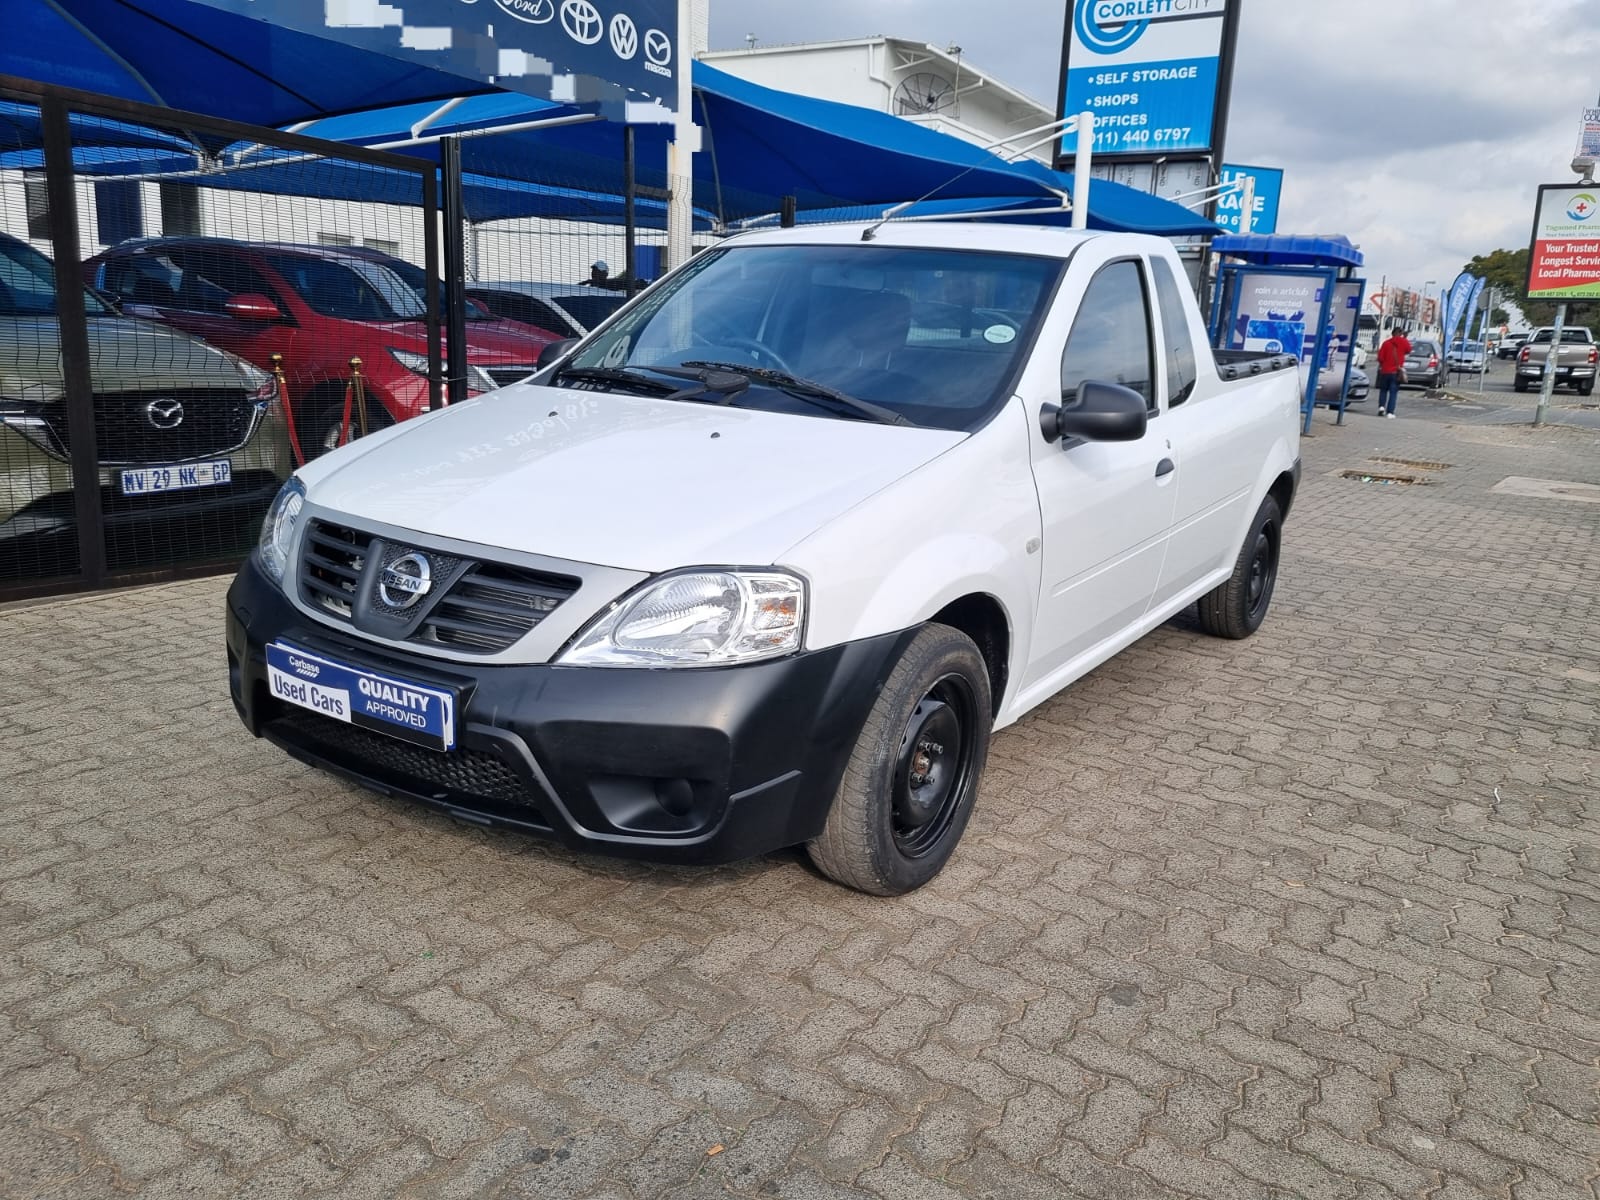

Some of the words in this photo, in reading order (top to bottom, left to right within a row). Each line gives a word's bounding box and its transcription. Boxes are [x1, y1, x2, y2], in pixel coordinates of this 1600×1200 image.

[1096, 72, 1129, 85] SELF
[1132, 66, 1198, 82] STORAGE
[1093, 93, 1139, 107] SHOPS
[1093, 114, 1148, 127] OFFICES
[1122, 130, 1150, 143] 440
[1154, 128, 1191, 141] 6797
[1546, 243, 1565, 253] Your
[1566, 243, 1598, 253] Trusted
[1540, 256, 1574, 267] Longest
[1538, 268, 1561, 278] Local
[1562, 269, 1600, 280] Pharmac
[152, 470, 171, 489] 29
[179, 466, 198, 485] NK
[212, 463, 229, 481] GP
[382, 571, 422, 589] NISSAN
[288, 655, 320, 674] Carbase
[273, 673, 307, 702] Used
[310, 686, 344, 716] Cars
[358, 677, 430, 713] QUALITY
[366, 701, 427, 729] APPROVED
